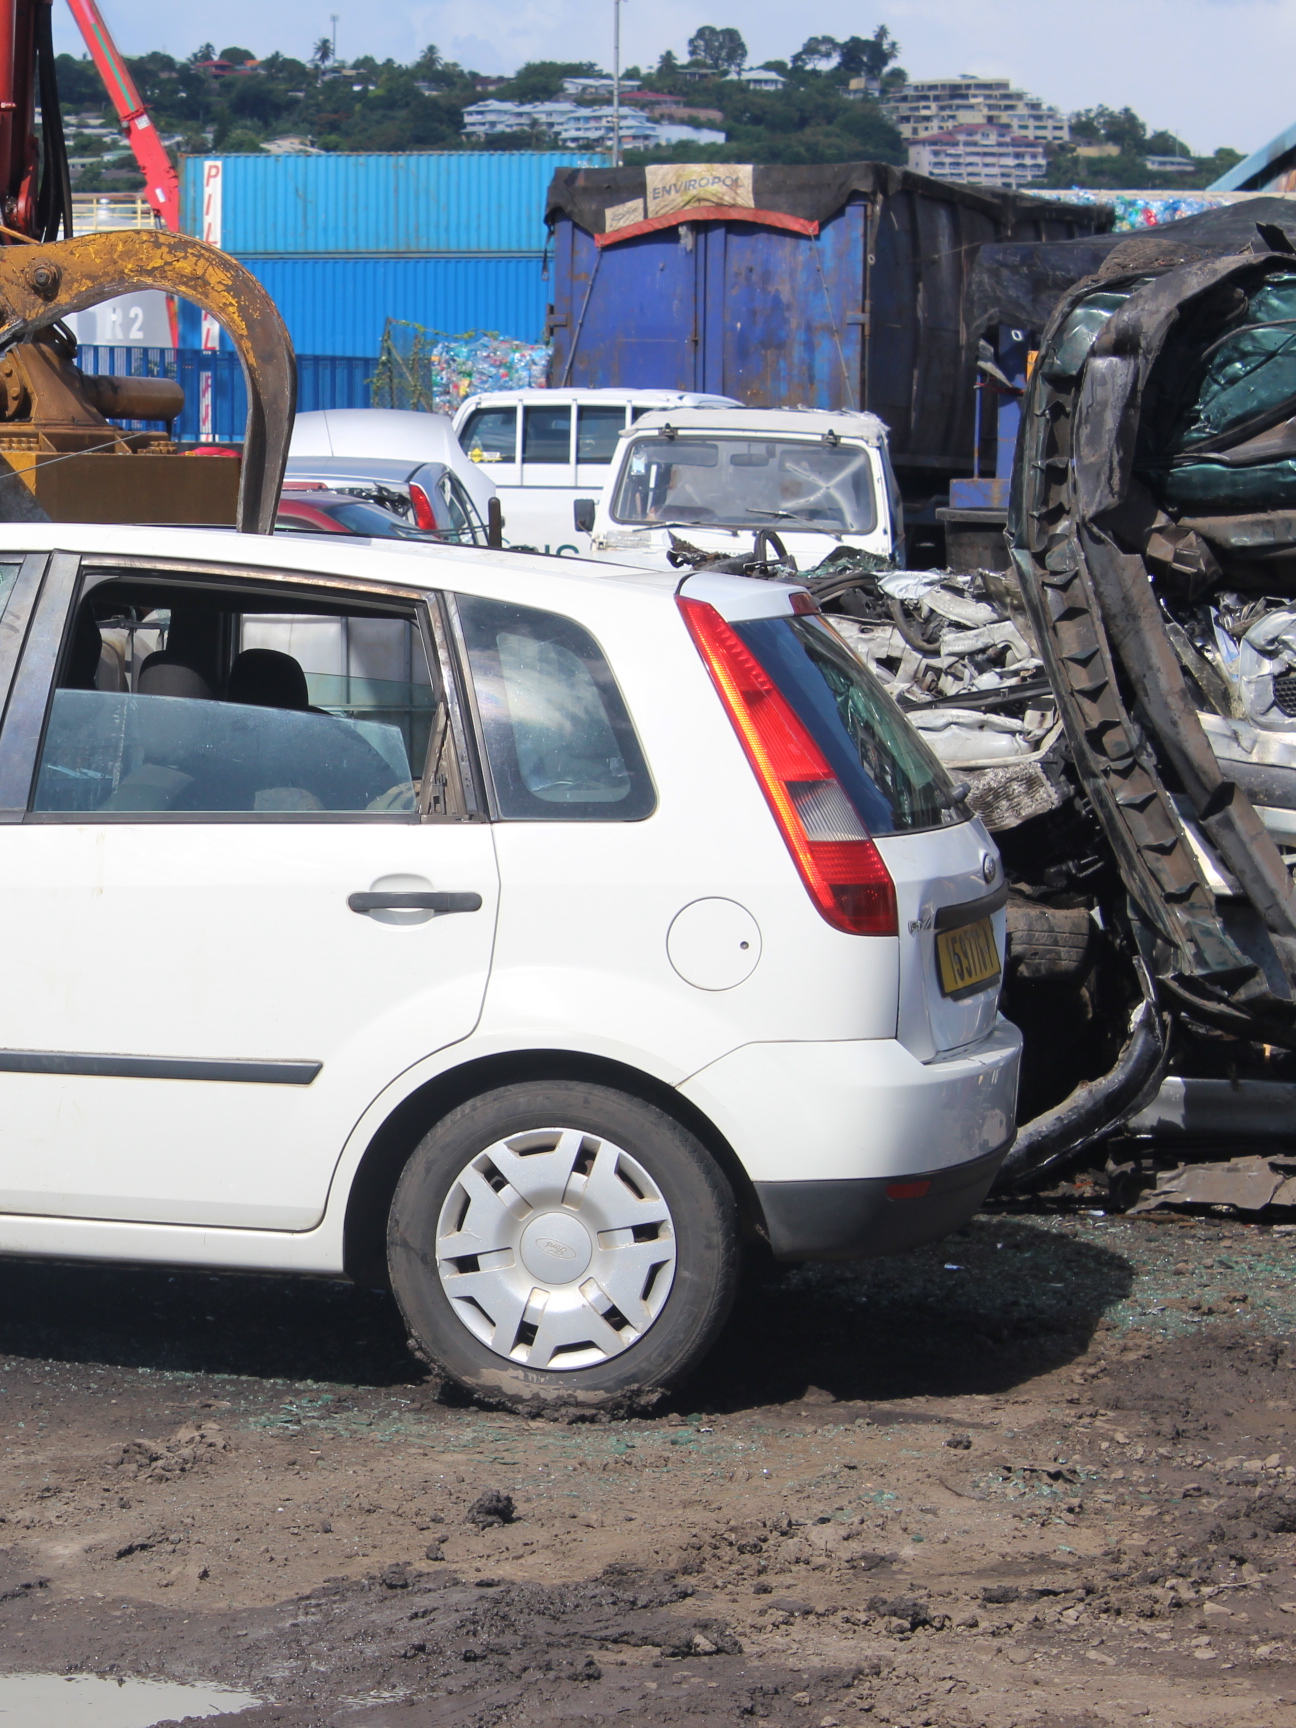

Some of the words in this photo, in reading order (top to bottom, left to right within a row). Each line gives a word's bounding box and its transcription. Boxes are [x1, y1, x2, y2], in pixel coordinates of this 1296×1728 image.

[652, 175, 744, 200] ENVIROPOL
[205, 165, 220, 245] PIL
[544, 1241, 567, 1256] Ford
